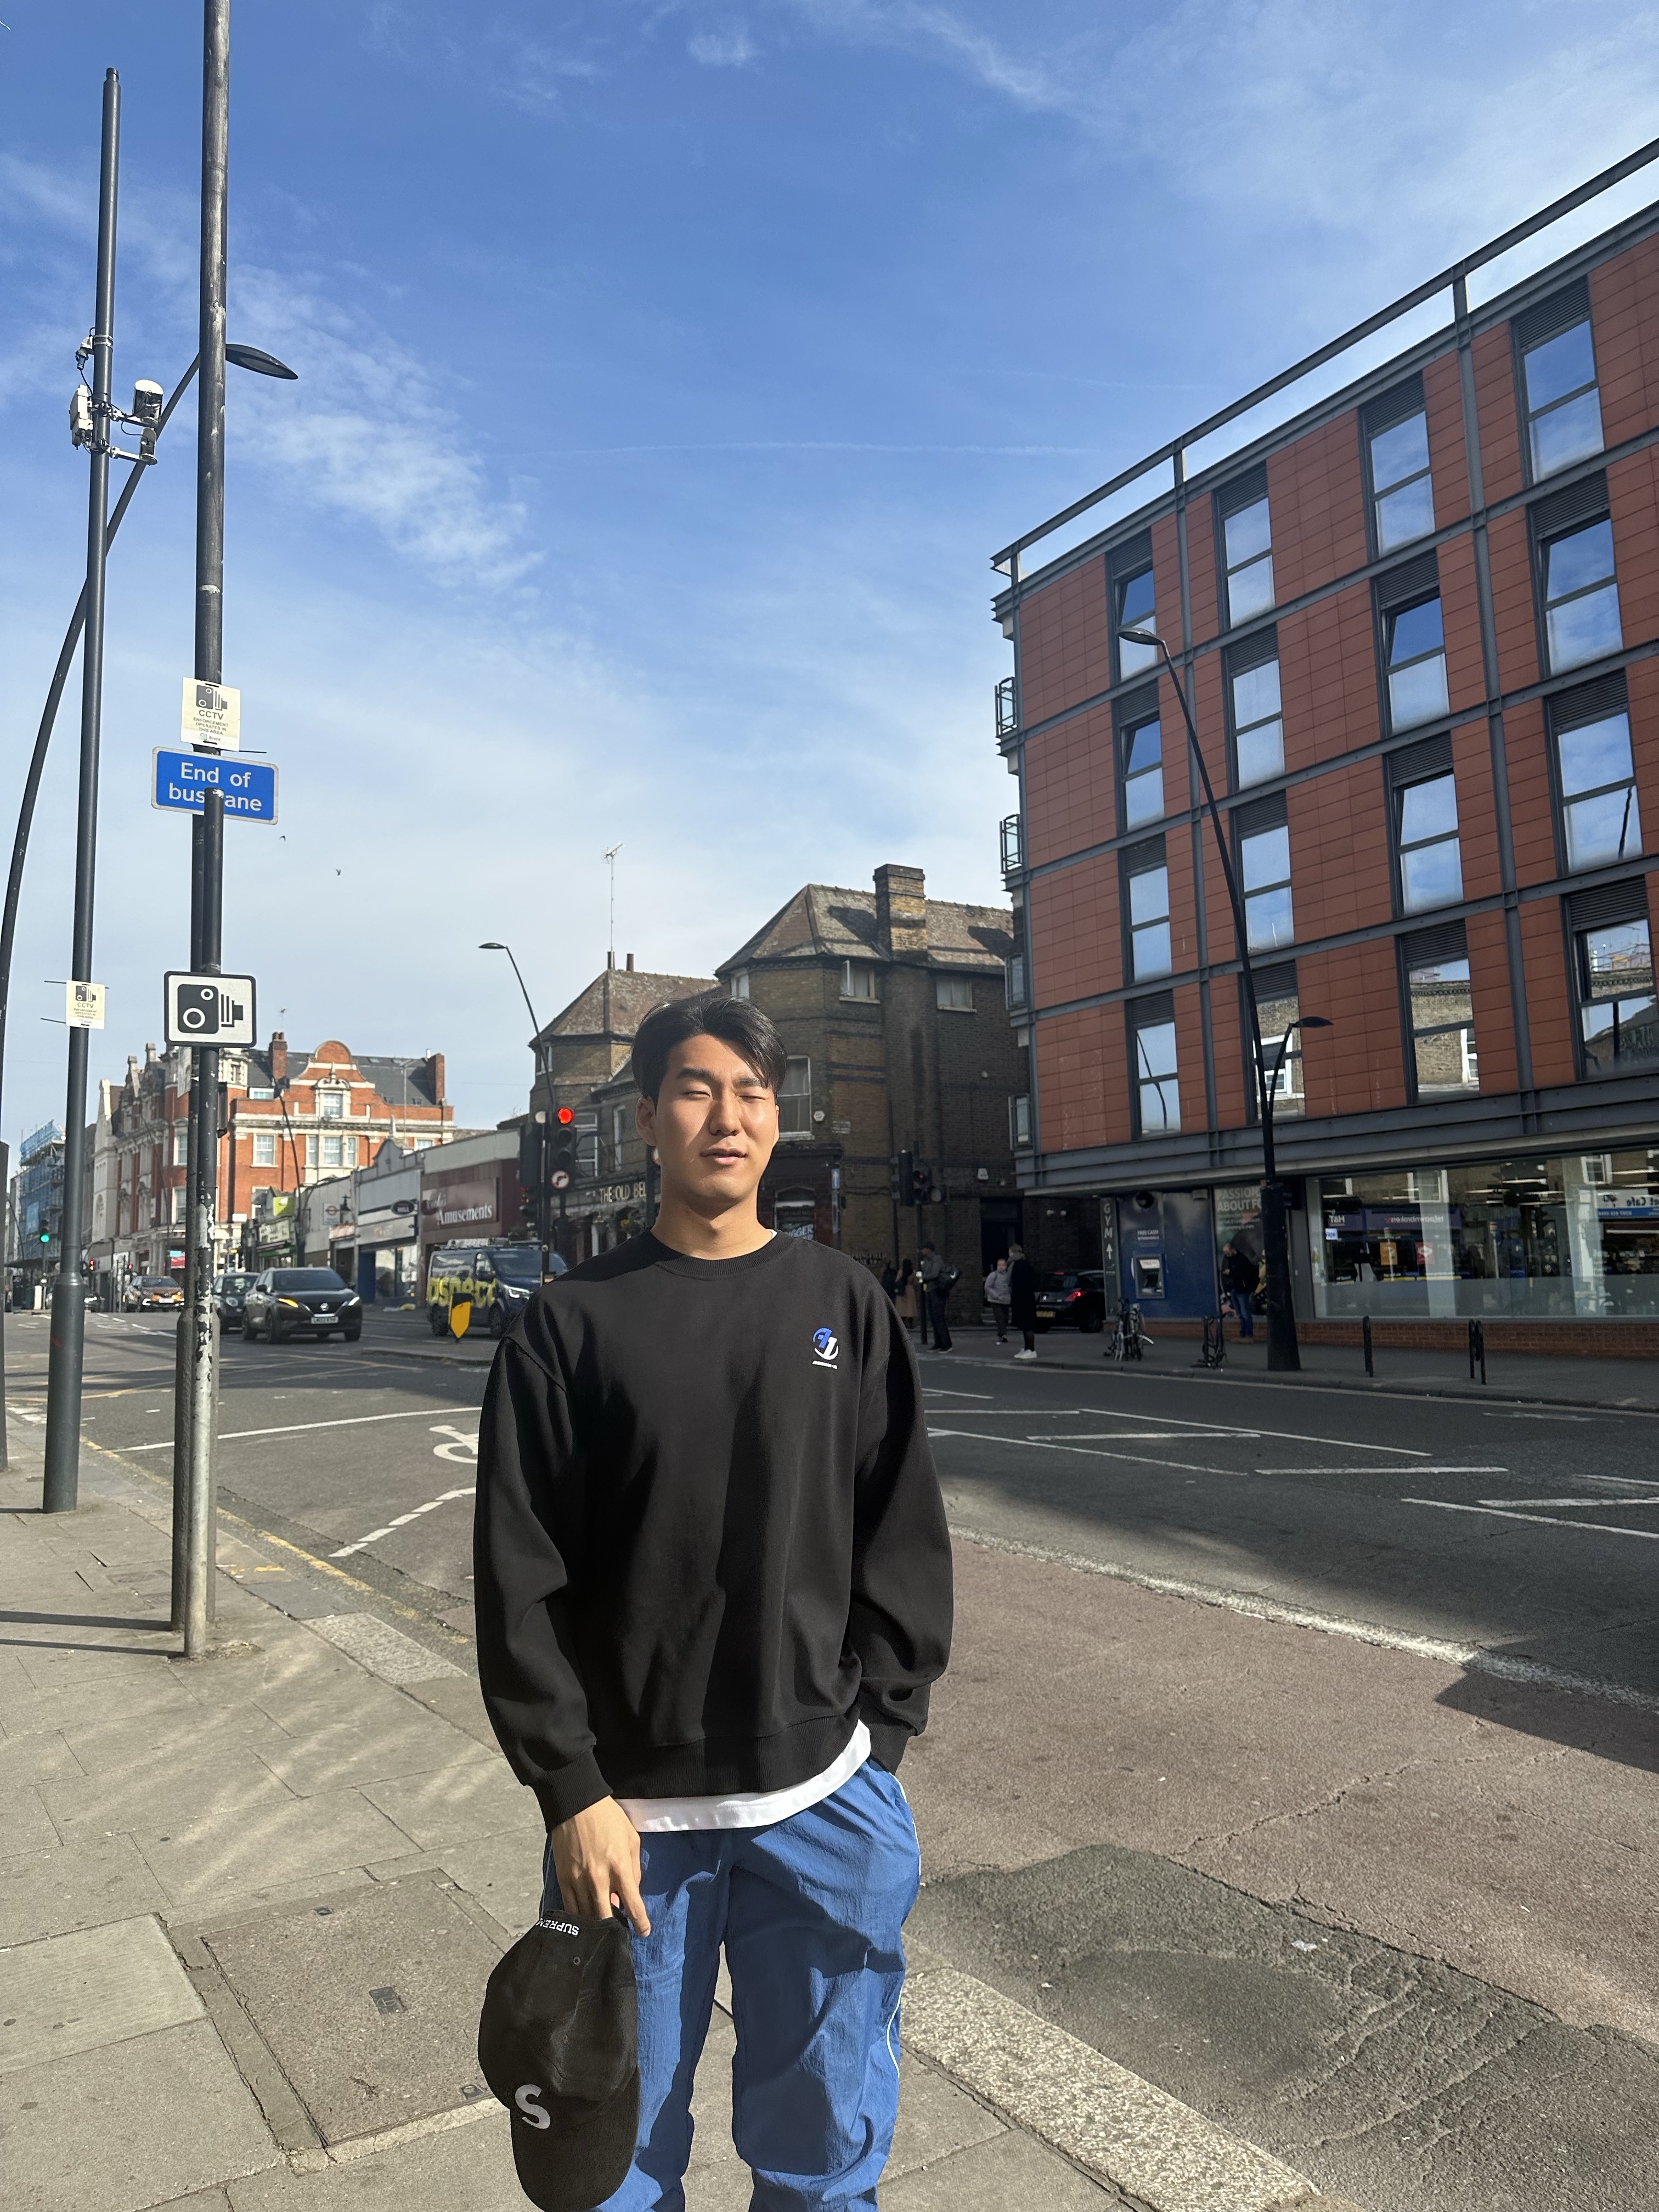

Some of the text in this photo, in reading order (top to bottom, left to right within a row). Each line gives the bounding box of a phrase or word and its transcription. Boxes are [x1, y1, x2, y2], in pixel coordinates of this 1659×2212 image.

[193, 717, 228, 727] ENFORCEMENT
[199, 709, 224, 720] CCTV
[195, 722, 221, 730] OPERATES
[181, 761, 251, 788] End of
[169, 782, 262, 811] bus ane
[599, 1187, 613, 1203] THE
[615, 1184, 630, 1200] OLD
[437, 1203, 492, 1225] Amusements
[1217, 1200, 1250, 1212] ABOUT
[1104, 1203, 1113, 1239] GYM
[515, 2084, 551, 2129] S
